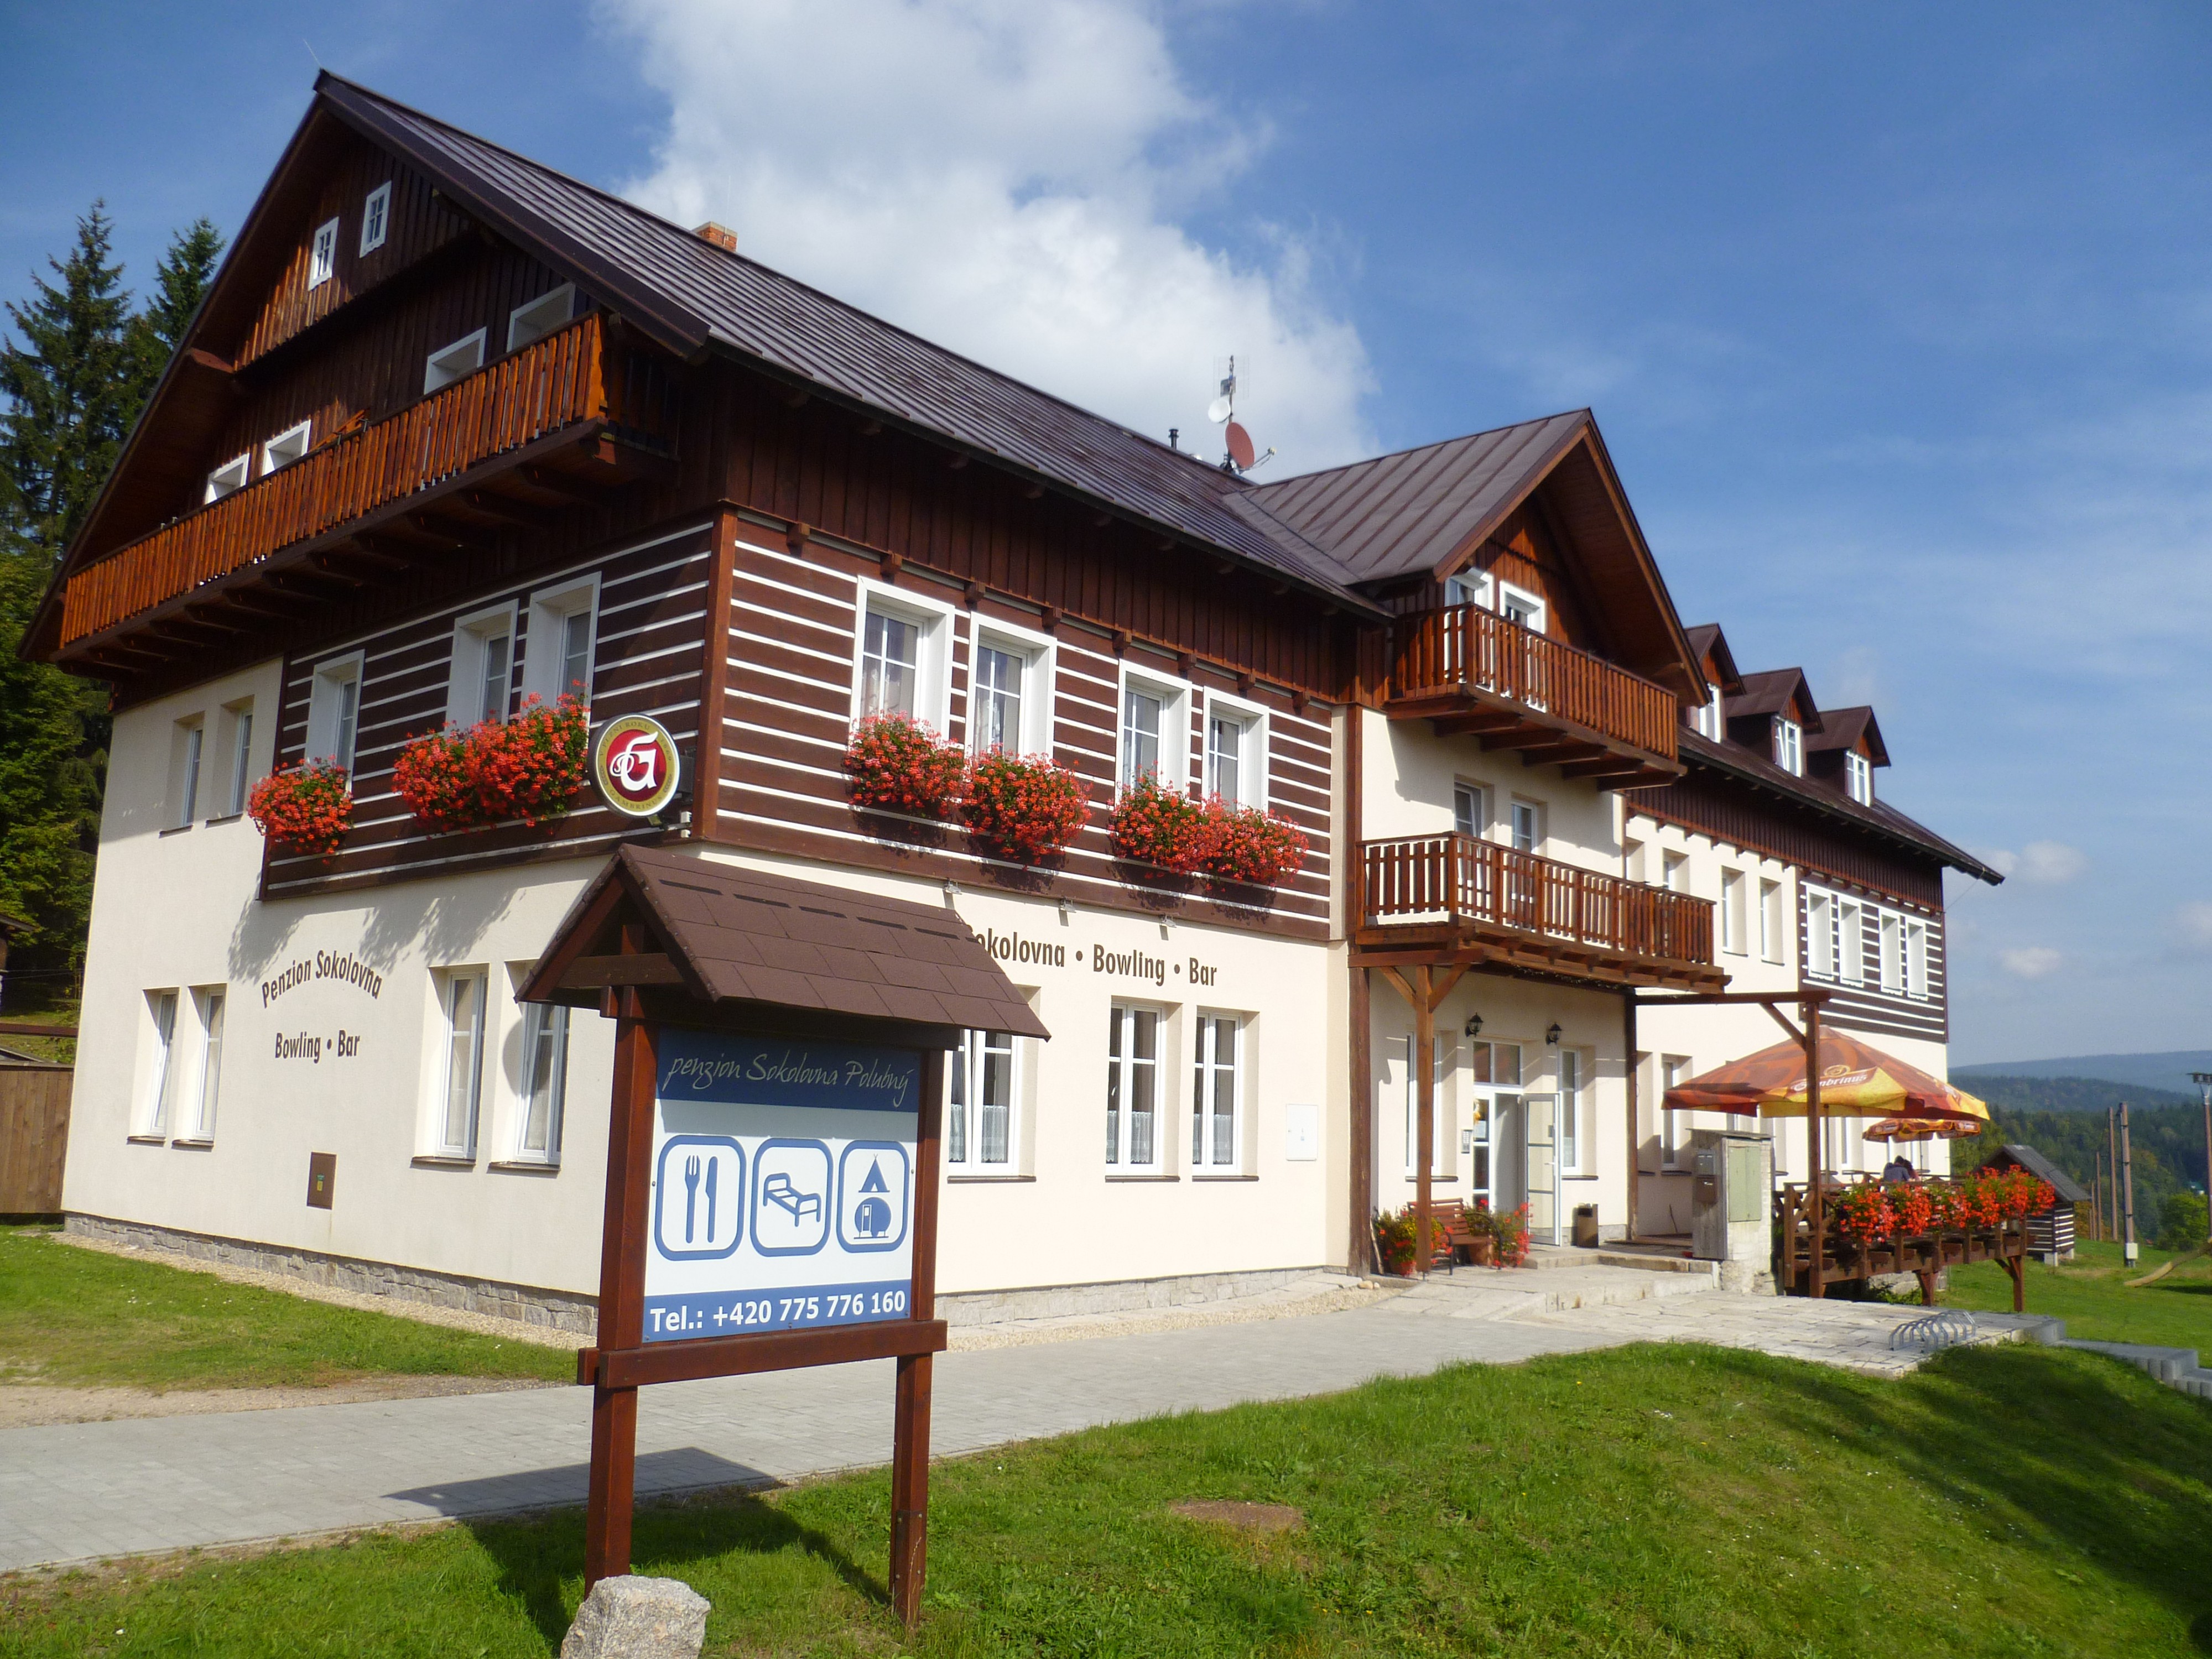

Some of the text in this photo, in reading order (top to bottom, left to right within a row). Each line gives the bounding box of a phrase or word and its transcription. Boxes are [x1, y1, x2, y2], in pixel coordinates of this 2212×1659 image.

[262, 950, 382, 1009] Penzion Sokolovna
[966, 925, 1217, 987] okolovna Bowling Bar
[275, 1030, 360, 1063] Bowling Bar
[662, 1050, 915, 1108] penzion Sokolovna Polubný
[650, 1290, 906, 1332] Tel.: +420 775 776 160
